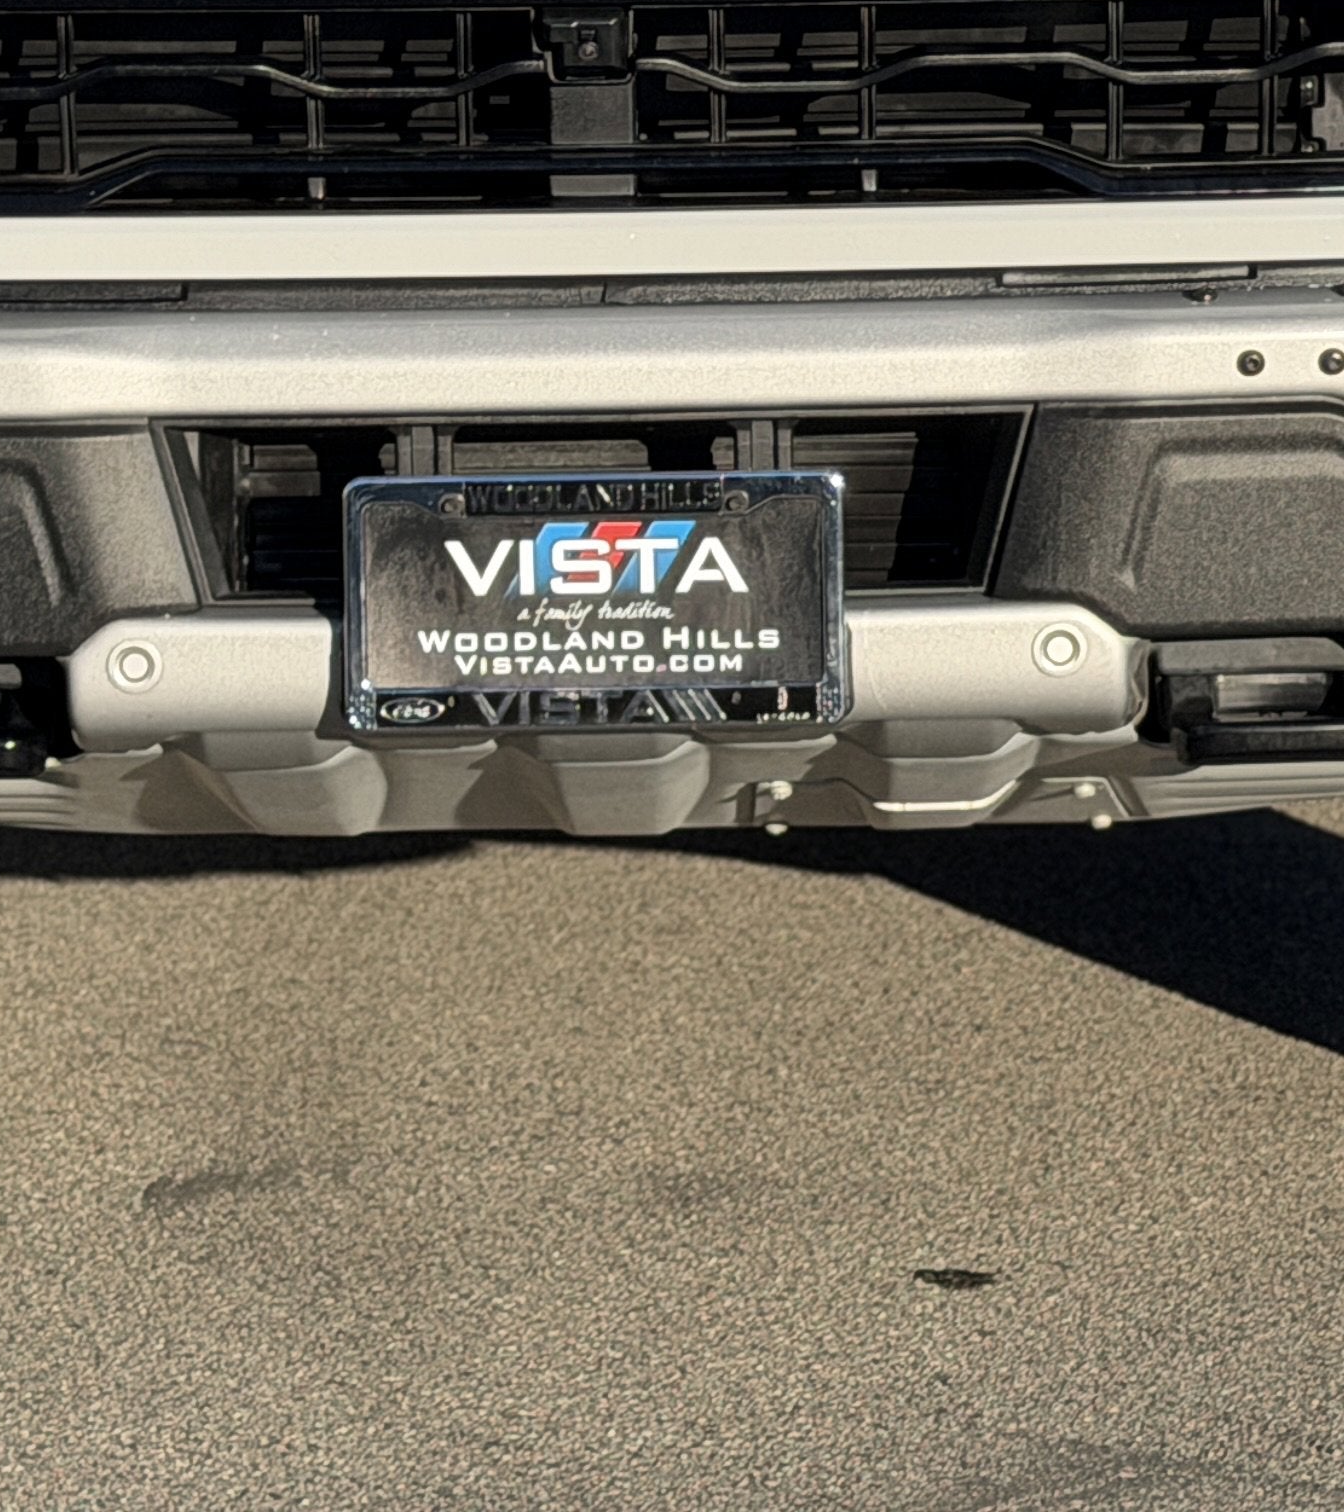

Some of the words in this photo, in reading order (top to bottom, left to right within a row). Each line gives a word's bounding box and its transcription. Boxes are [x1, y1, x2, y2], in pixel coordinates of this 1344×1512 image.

[466, 484, 634, 513] WOODLAND
[444, 536, 750, 597] VISTA
[516, 606, 531, 621] a
[532, 597, 593, 632] family
[597, 599, 675, 621] tradition
[417, 629, 646, 653] WOODLAND
[661, 625, 781, 651] HILLS
